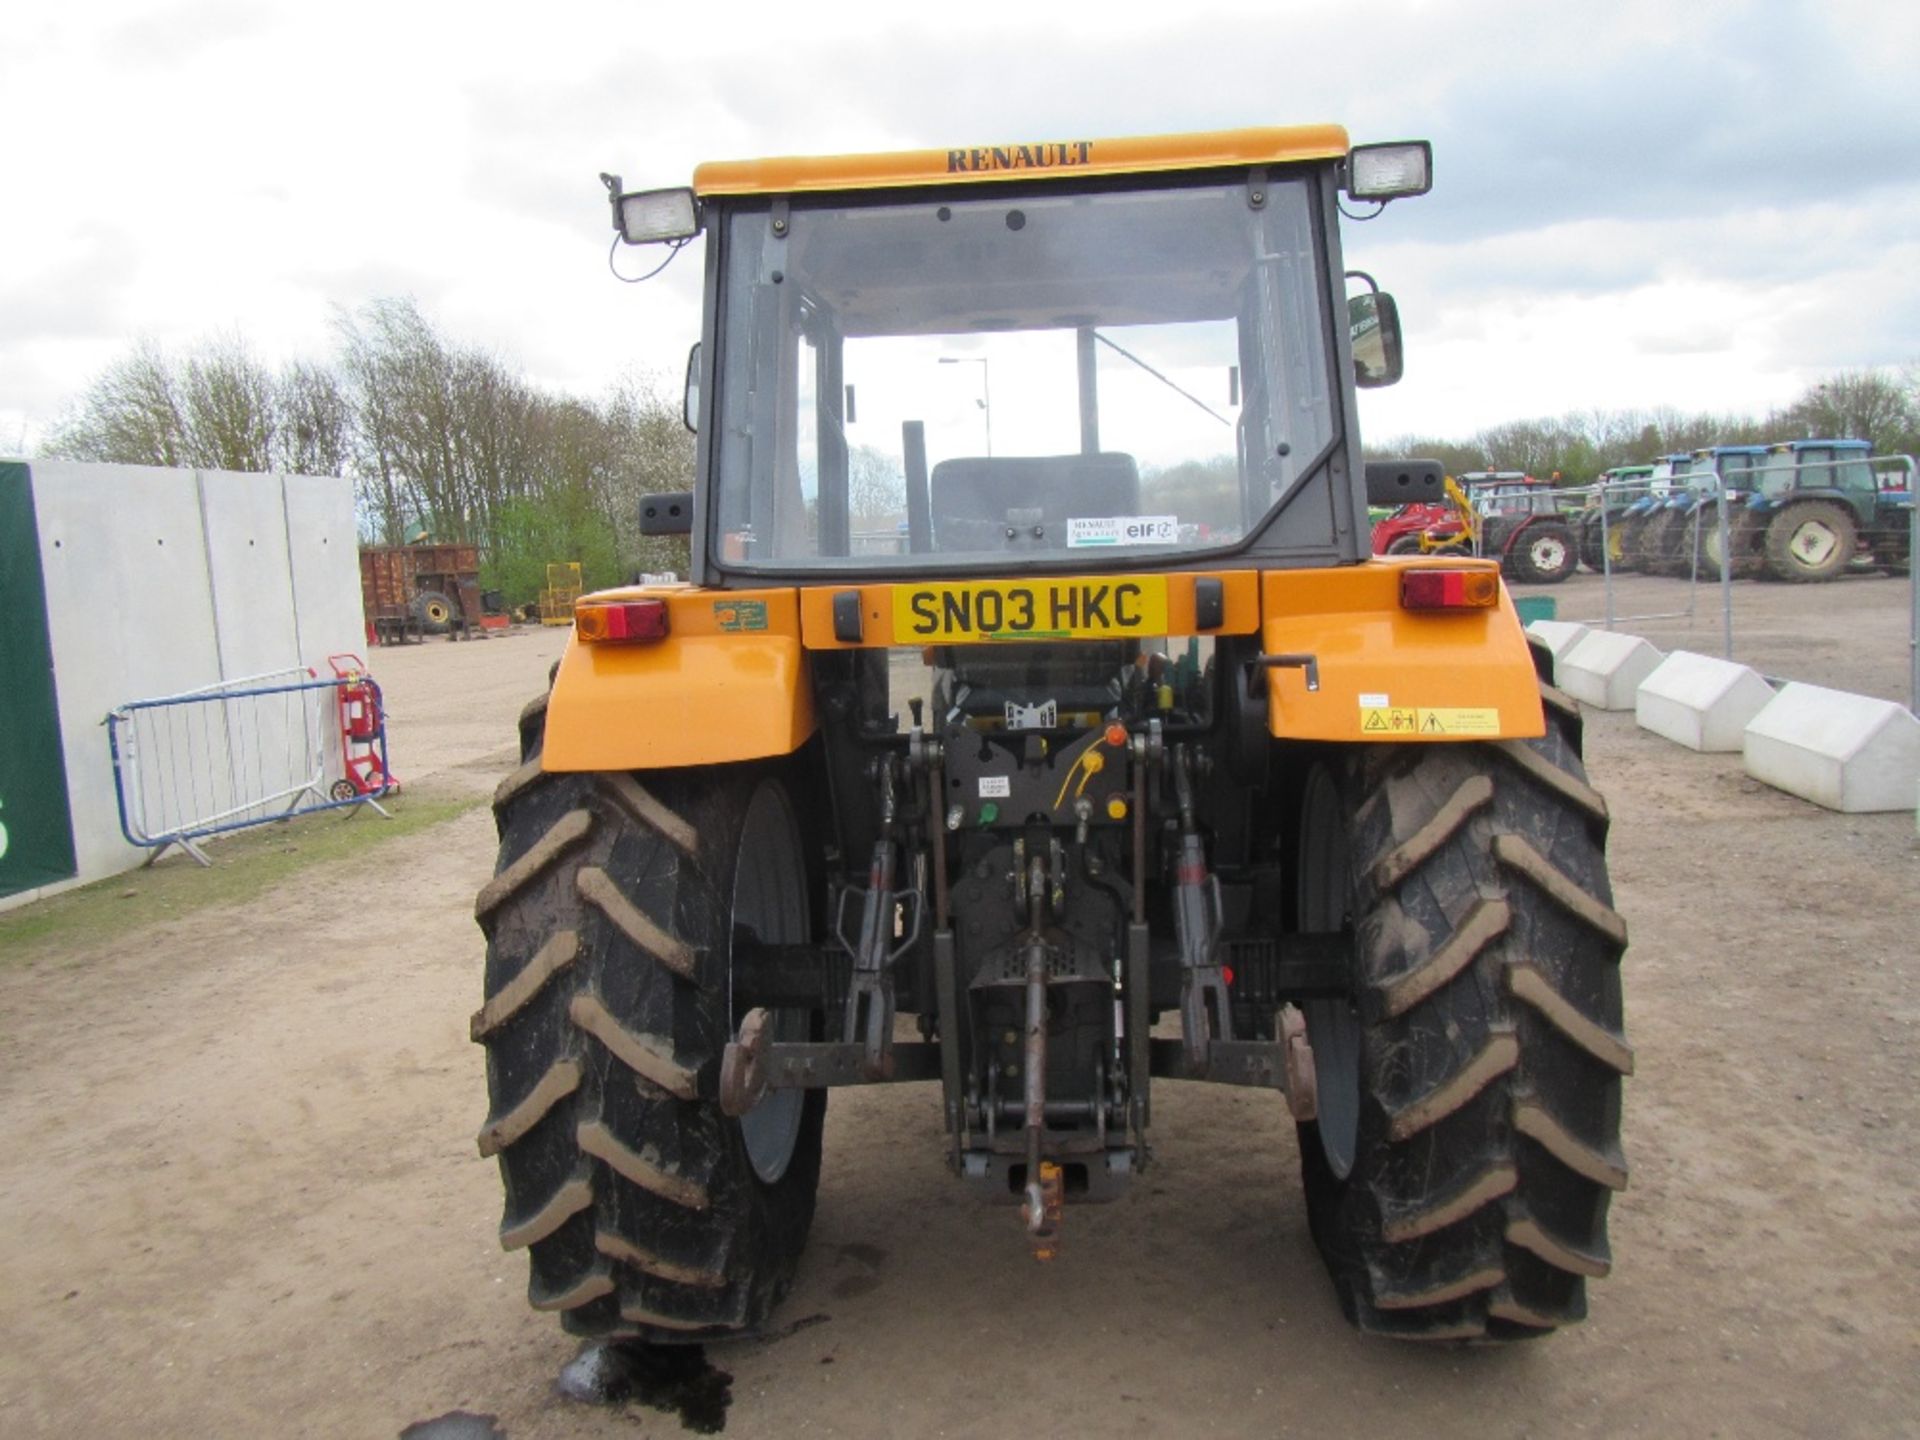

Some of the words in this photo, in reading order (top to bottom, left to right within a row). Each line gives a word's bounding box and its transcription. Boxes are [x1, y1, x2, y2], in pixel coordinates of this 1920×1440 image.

[947, 141, 1093, 173] RENAULT
[1127, 524, 1155, 538] elf
[911, 589, 1035, 634] SN03
[1050, 583, 1142, 629] HKC
